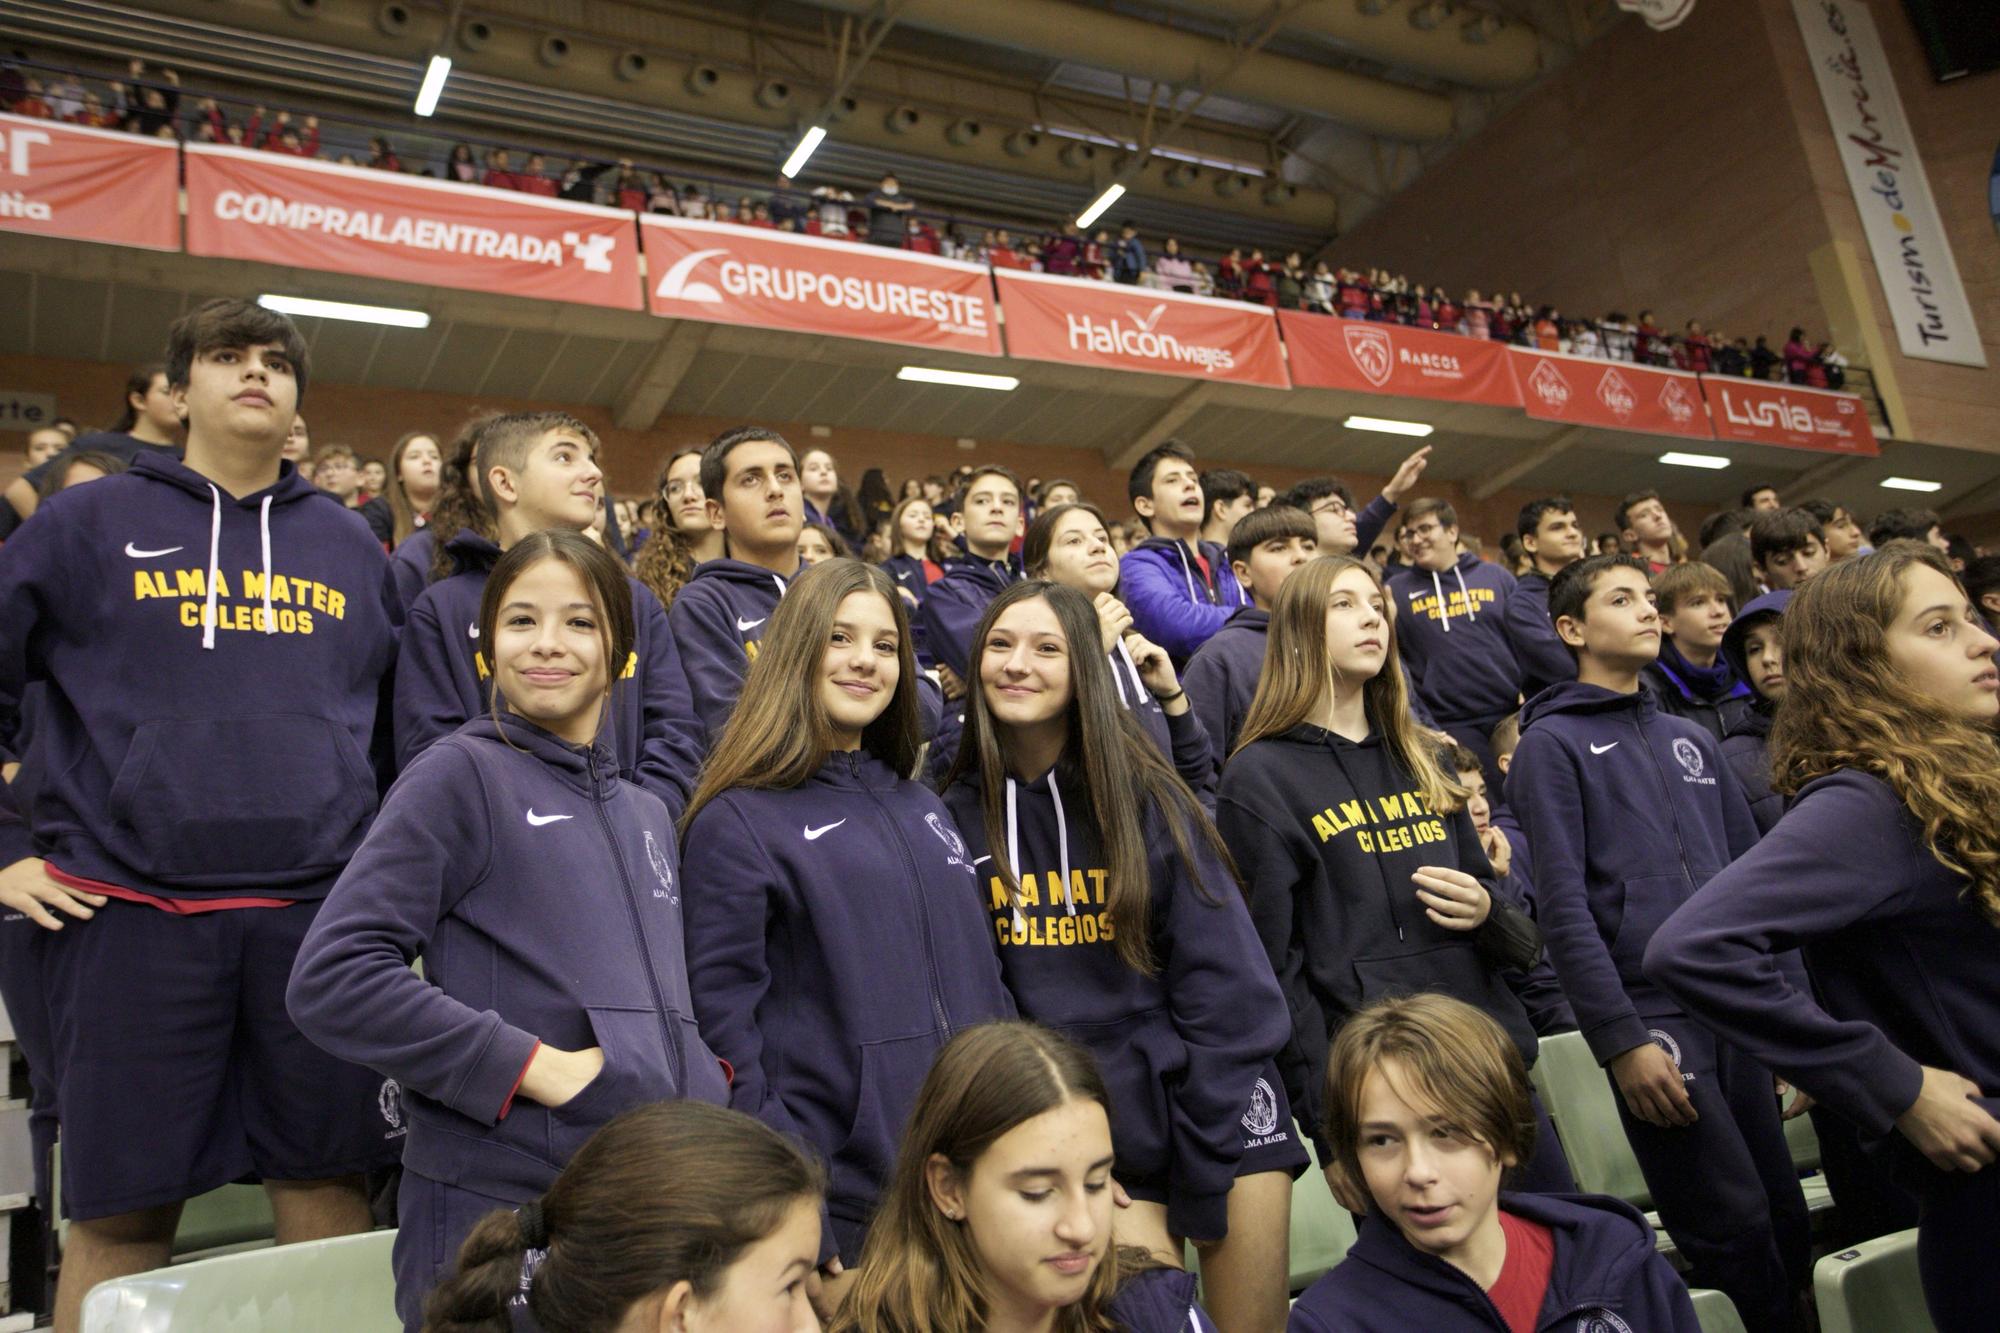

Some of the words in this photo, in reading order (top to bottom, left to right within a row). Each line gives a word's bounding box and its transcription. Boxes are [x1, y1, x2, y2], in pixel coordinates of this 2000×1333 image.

[214, 190, 564, 267] COMPRALAENTRADA
[719, 260, 988, 329] GRUPOSURESTE
[134, 568, 231, 601] ALMA
[242, 569, 347, 621] MATER
[1047, 868, 1110, 907] MAT
[1682, 1072, 1697, 1081] TER
[1243, 1139, 1263, 1149] LMA
[1264, 1132, 1289, 1146] MATER
